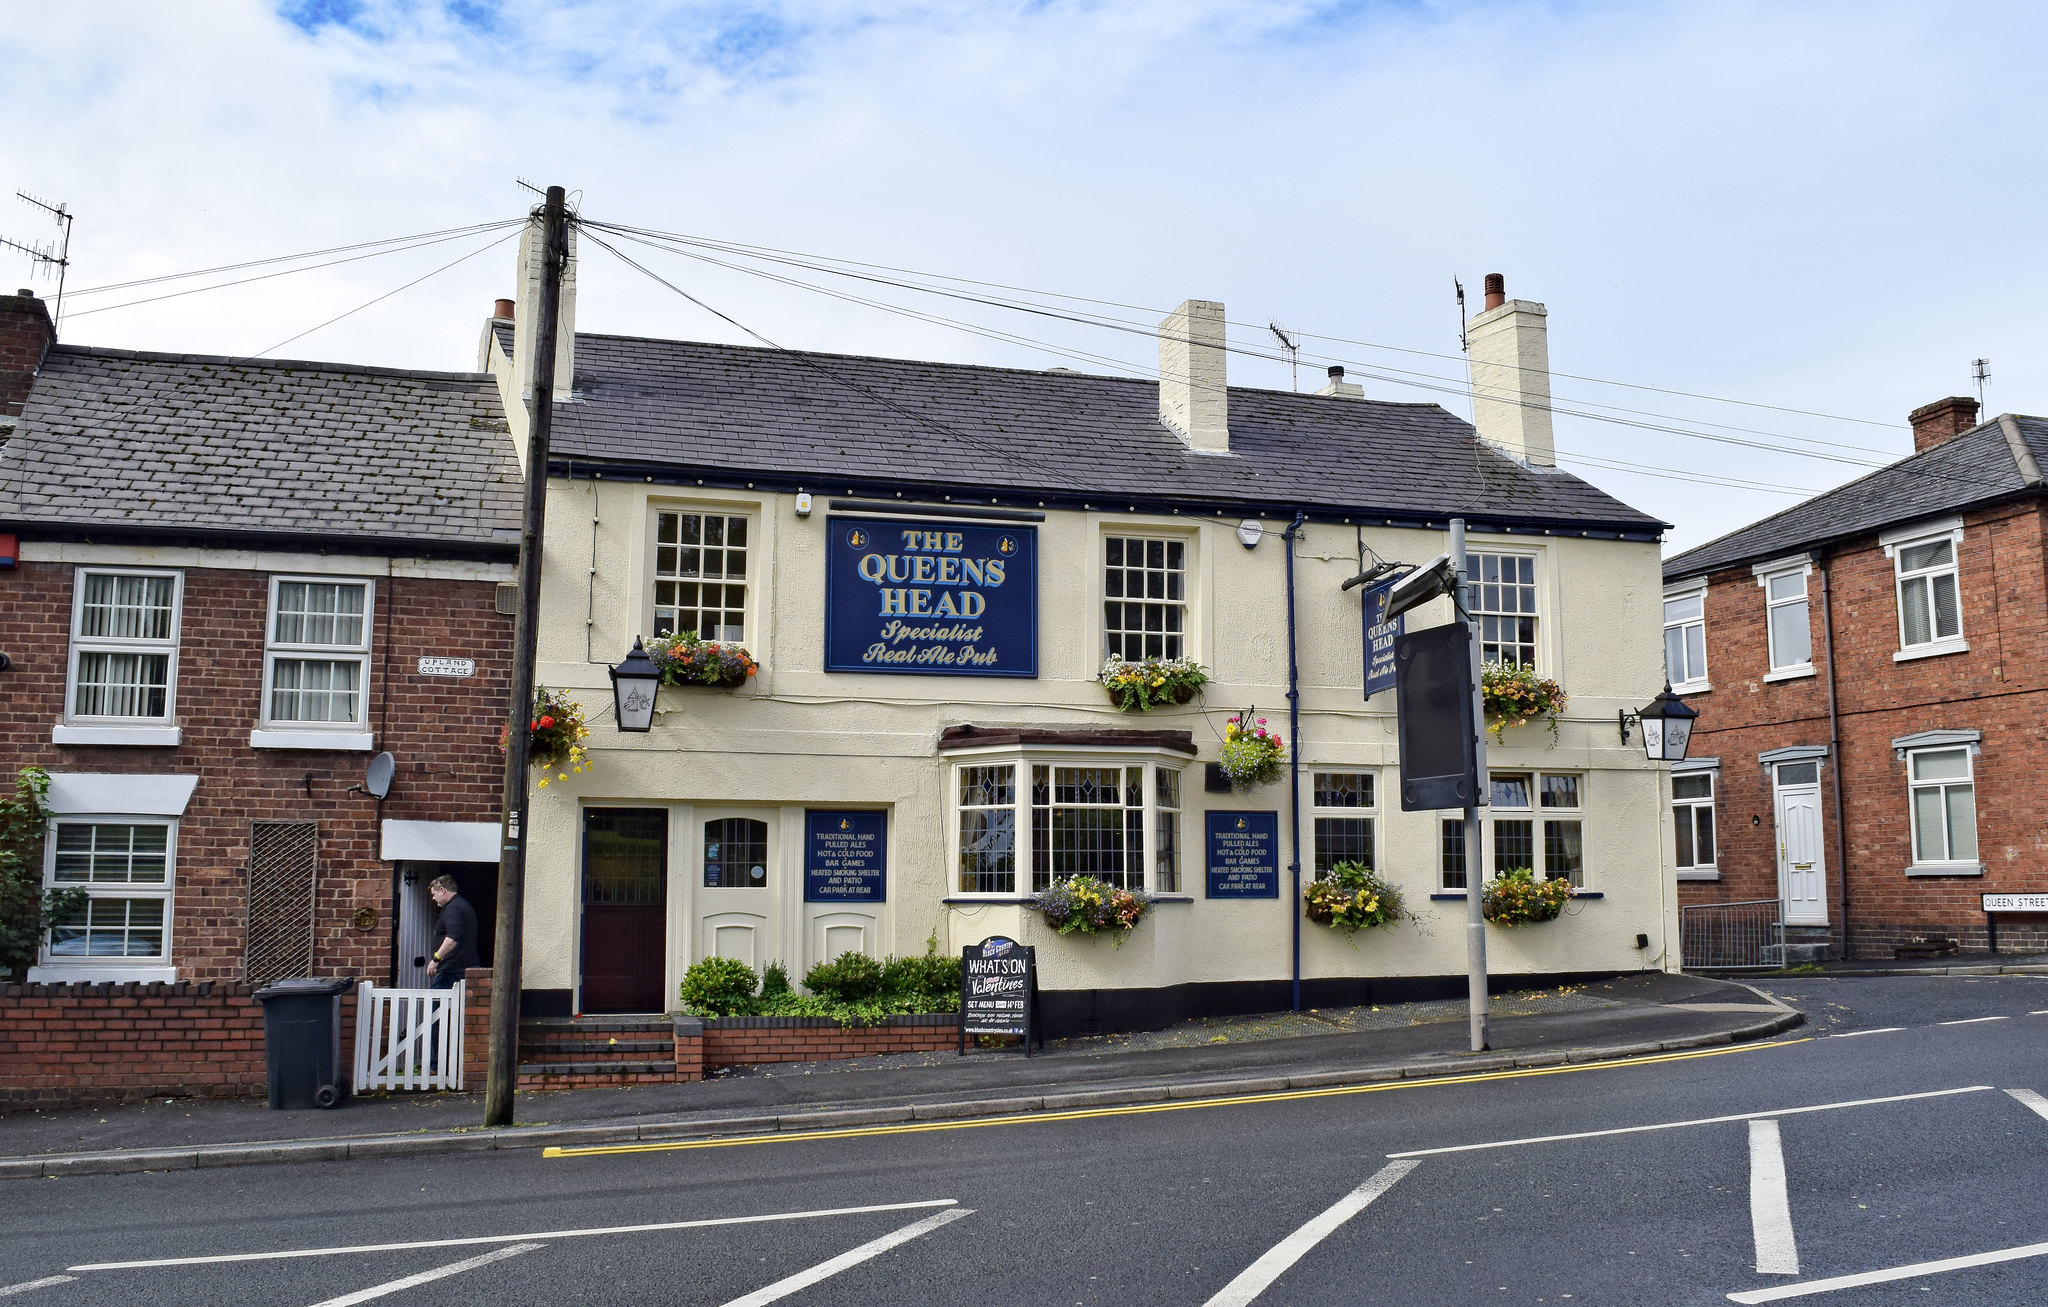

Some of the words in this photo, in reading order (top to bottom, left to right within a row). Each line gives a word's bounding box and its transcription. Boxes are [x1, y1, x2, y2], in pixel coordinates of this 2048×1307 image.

[902, 531, 963, 553] THE
[858, 554, 1006, 588] QUEEN'S
[879, 588, 986, 619] HEAD
[881, 620, 983, 645] Specialist
[1373, 634, 1394, 652] HEAD
[863, 642, 916, 664] Real
[916, 646, 955, 665] Ale
[956, 646, 997, 666] Pub
[1985, 898, 2013, 907] QUEEN
[2018, 898, 2048, 907] STREE
[982, 948, 995, 958] BLACK
[996, 941, 1013, 953] COUNTRY
[969, 959, 1009, 974] WHAT'S
[1011, 959, 1026, 974] ON
[972, 976, 1023, 995] Valentines
[968, 1000, 978, 1009] SET
[979, 1000, 994, 1009] MENU
[1015, 1001, 1024, 1009] FEB
